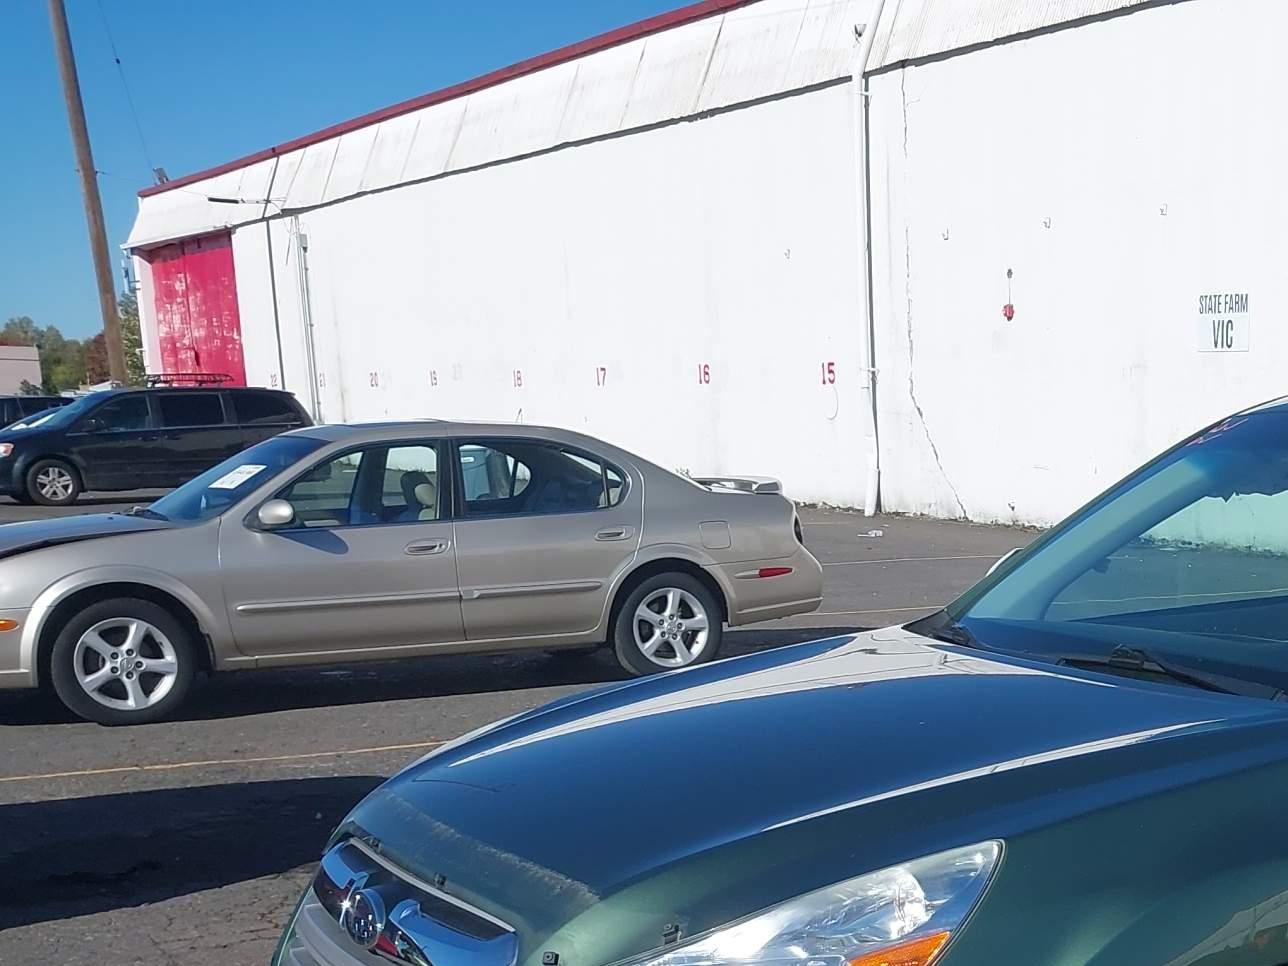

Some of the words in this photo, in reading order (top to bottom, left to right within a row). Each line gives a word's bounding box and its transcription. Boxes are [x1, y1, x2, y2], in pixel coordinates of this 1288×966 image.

[1199, 294, 1222, 315] STATE
[1224, 293, 1249, 313] FARM
[1212, 319, 1234, 349] VIC
[369, 372, 379, 387] 20
[513, 370, 522, 387] 18
[596, 367, 606, 386] 17
[698, 364, 710, 384] 16
[821, 362, 835, 385] 15
